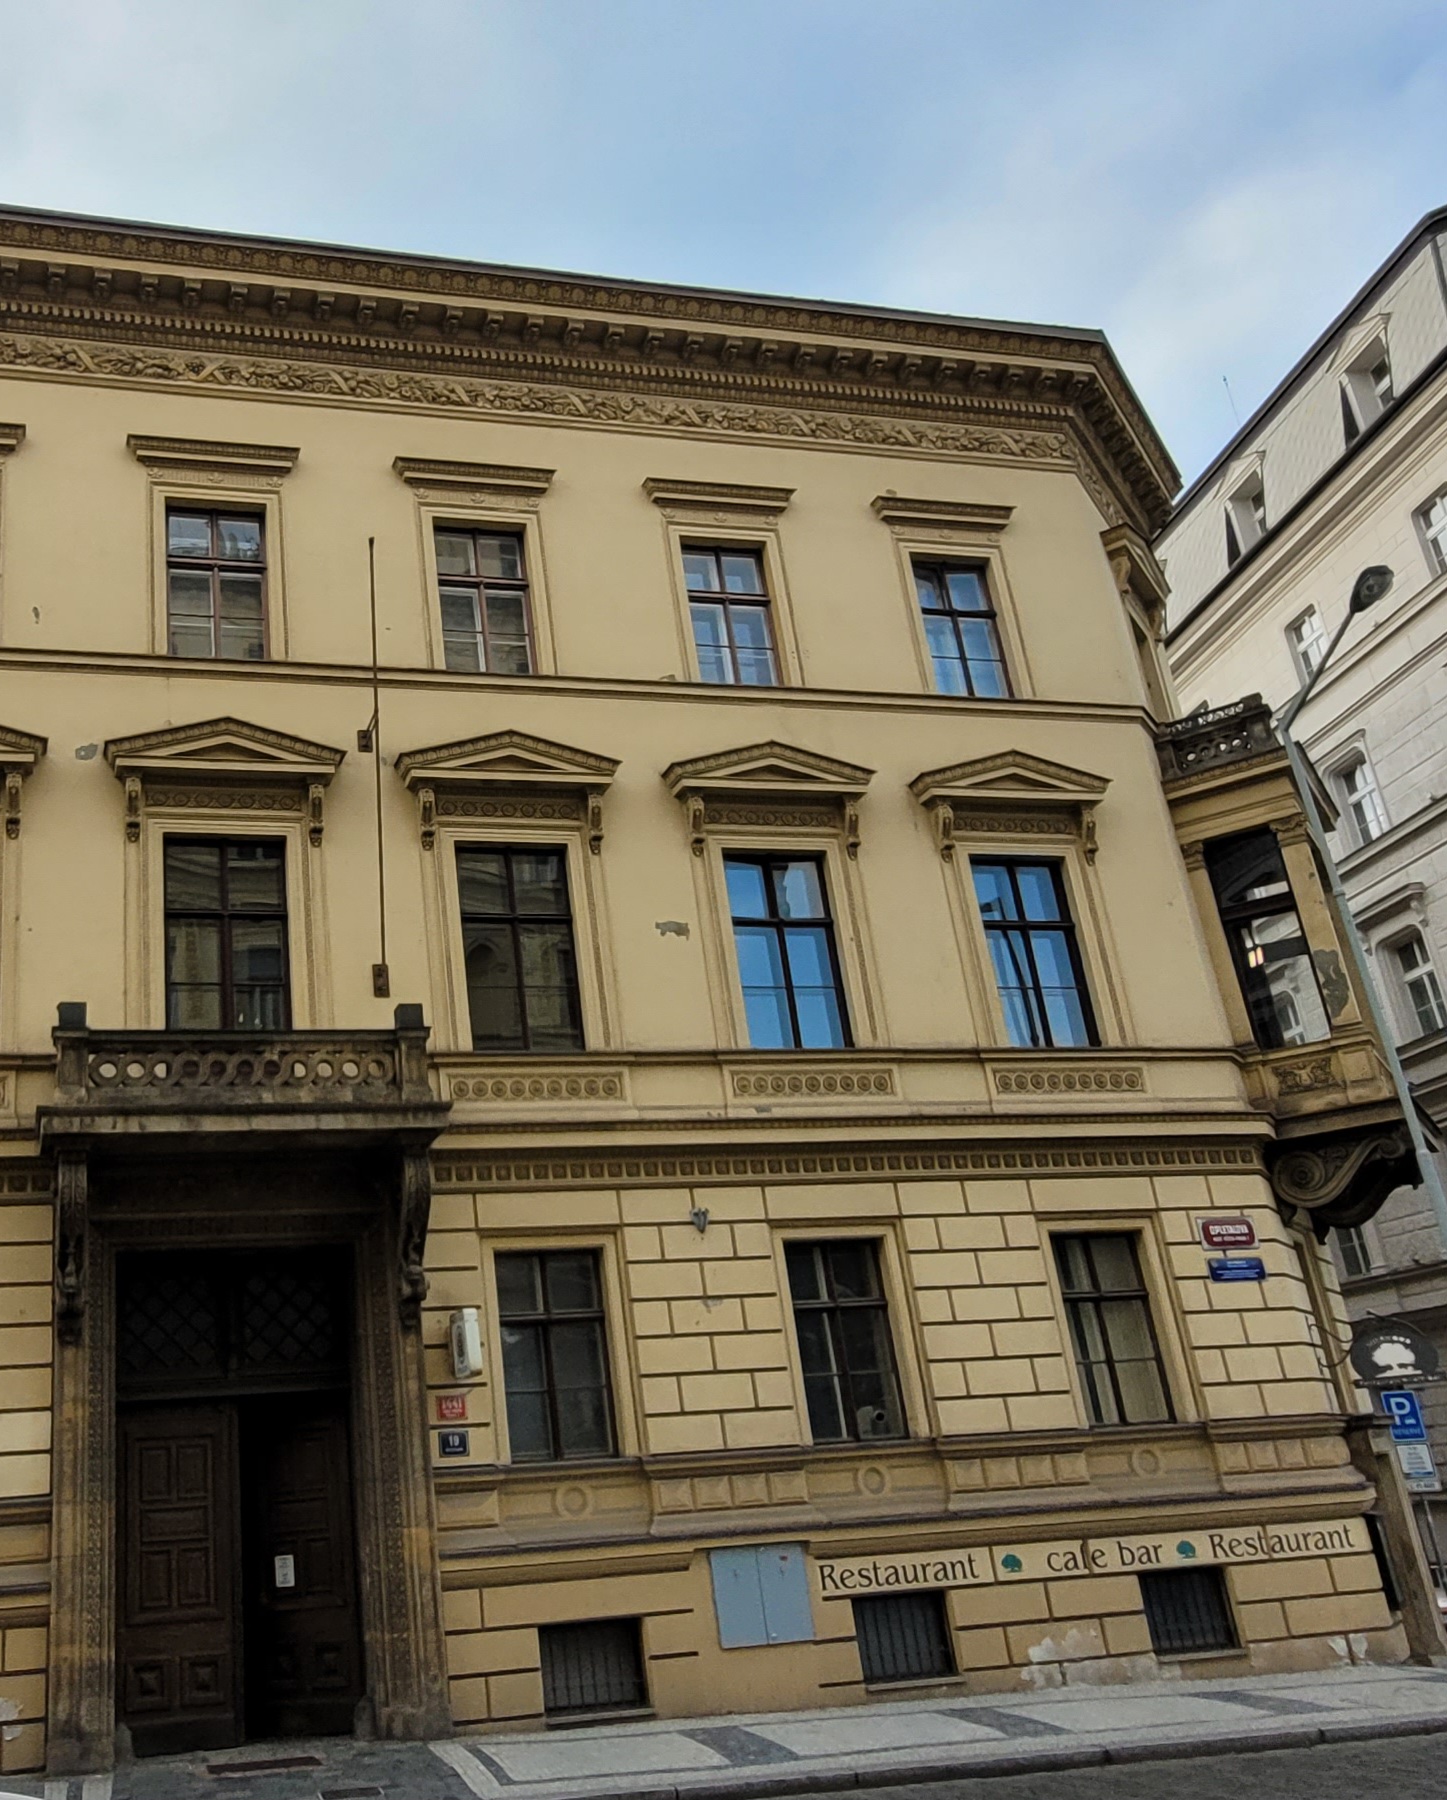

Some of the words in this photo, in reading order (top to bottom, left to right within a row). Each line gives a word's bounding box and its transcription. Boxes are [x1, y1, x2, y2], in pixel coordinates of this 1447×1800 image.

[1389, 1397, 1411, 1426] P
[448, 1435, 460, 1447] 19
[818, 1553, 980, 1592] Restaurant
[1116, 1540, 1163, 1567] bar
[1208, 1524, 1356, 1560] Restaurant
